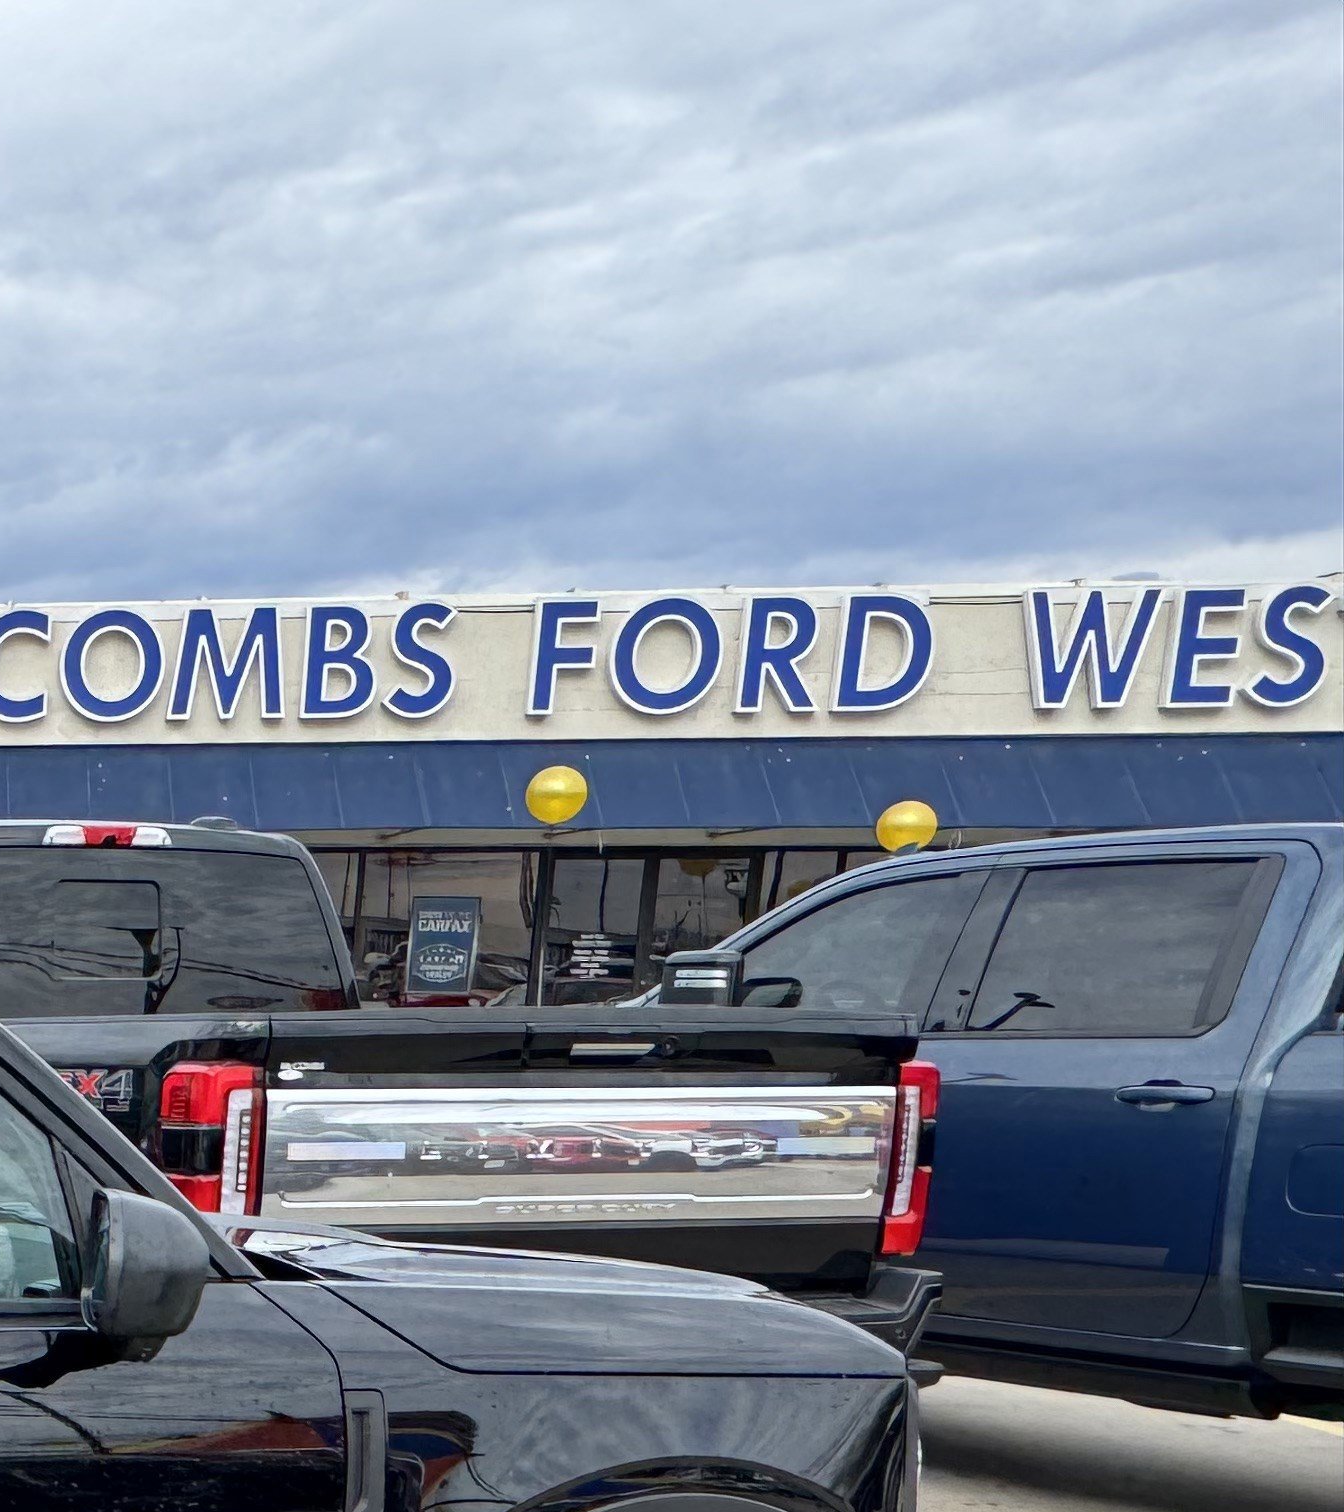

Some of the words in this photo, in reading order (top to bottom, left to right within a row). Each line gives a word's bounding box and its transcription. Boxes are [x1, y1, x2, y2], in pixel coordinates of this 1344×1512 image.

[527, 593, 936, 714] FORD
[1028, 583, 1338, 710] WES
[418, 919, 472, 933] CARFAX
